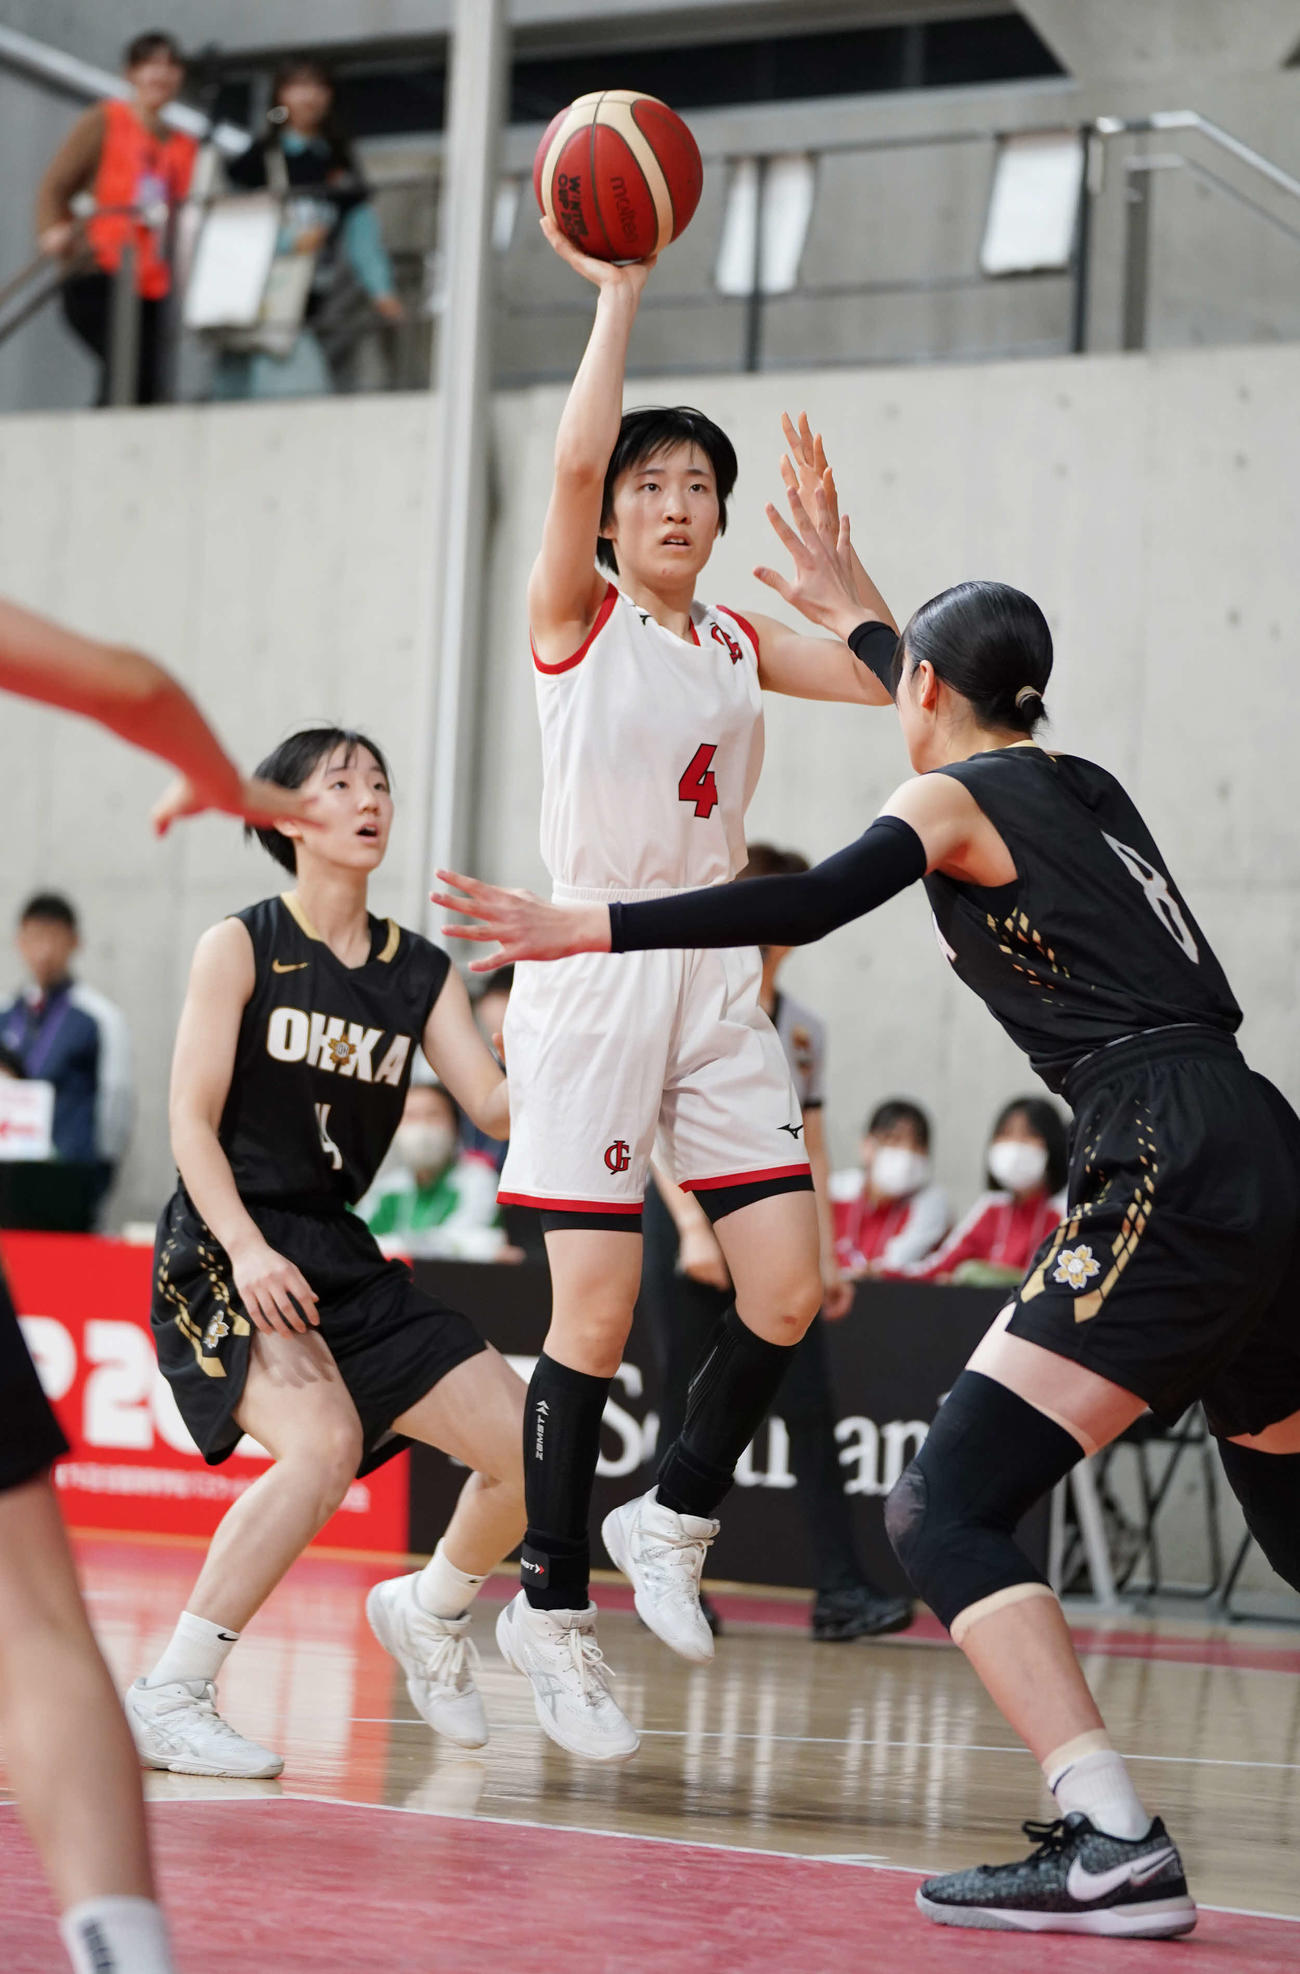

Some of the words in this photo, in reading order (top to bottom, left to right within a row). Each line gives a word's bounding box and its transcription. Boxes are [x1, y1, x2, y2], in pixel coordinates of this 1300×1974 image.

[678, 742, 719, 819] 4
[1100, 829, 1200, 965] 8
[266, 1005, 412, 1087] OHKA
